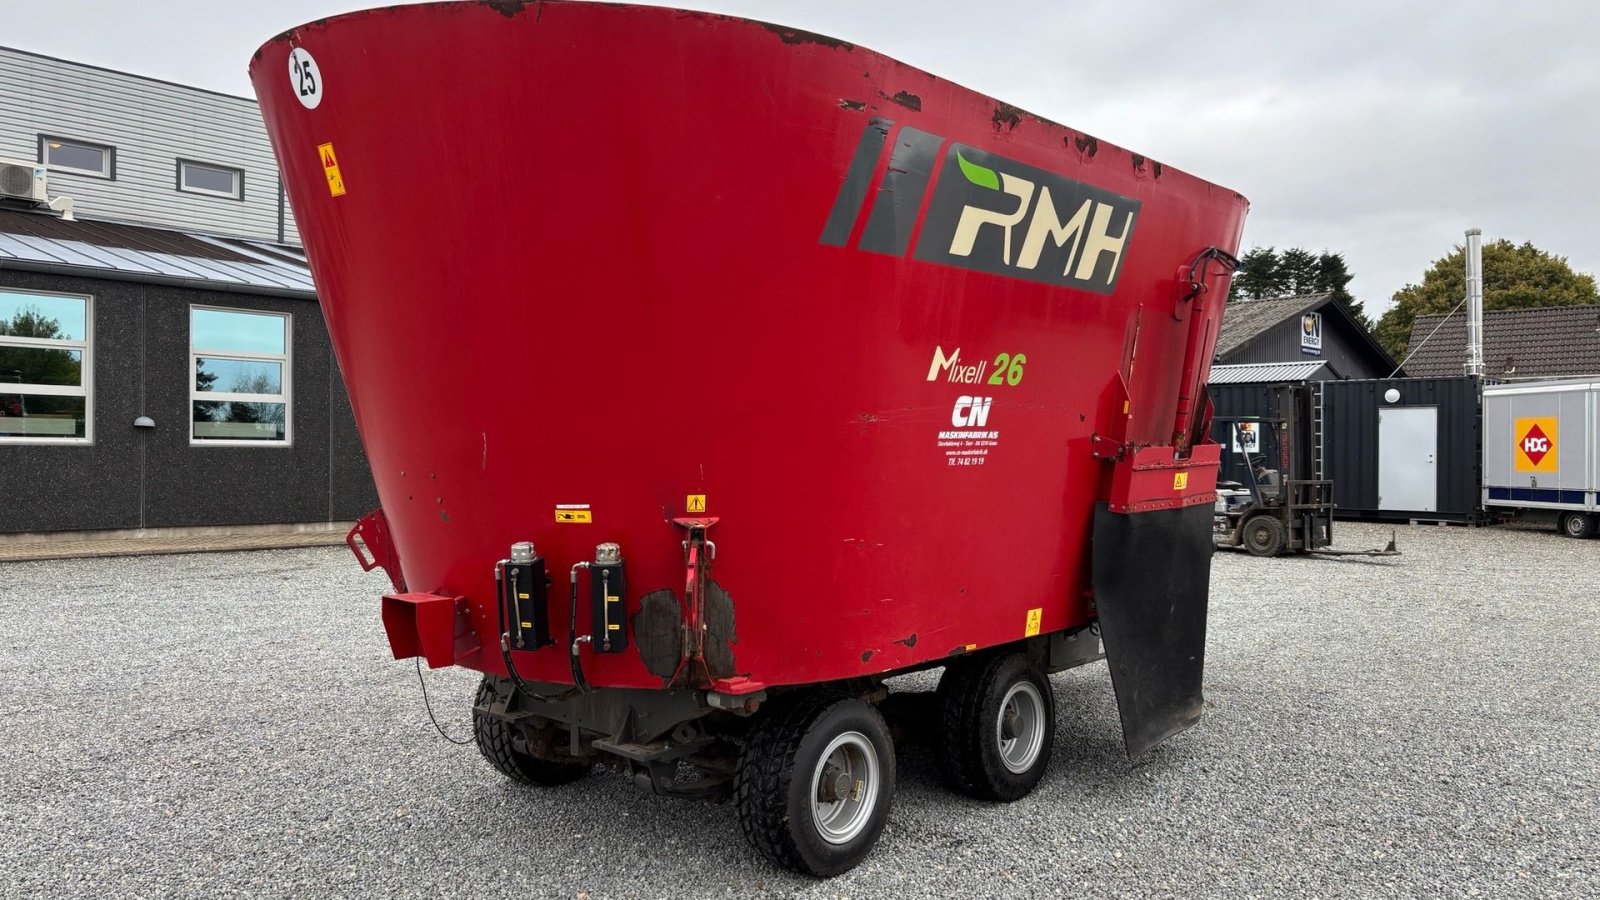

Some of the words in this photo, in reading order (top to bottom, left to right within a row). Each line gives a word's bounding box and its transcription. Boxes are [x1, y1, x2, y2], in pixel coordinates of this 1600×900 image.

[294, 60, 316, 97] 25
[949, 171, 1134, 286] RMH
[1303, 335, 1320, 346] ENERGY
[926, 345, 988, 384] Mixell
[987, 352, 1027, 387] 26
[951, 395, 992, 428] CN
[938, 431, 988, 440] MASKINFABRIK
[1524, 437, 1547, 453] HDG
